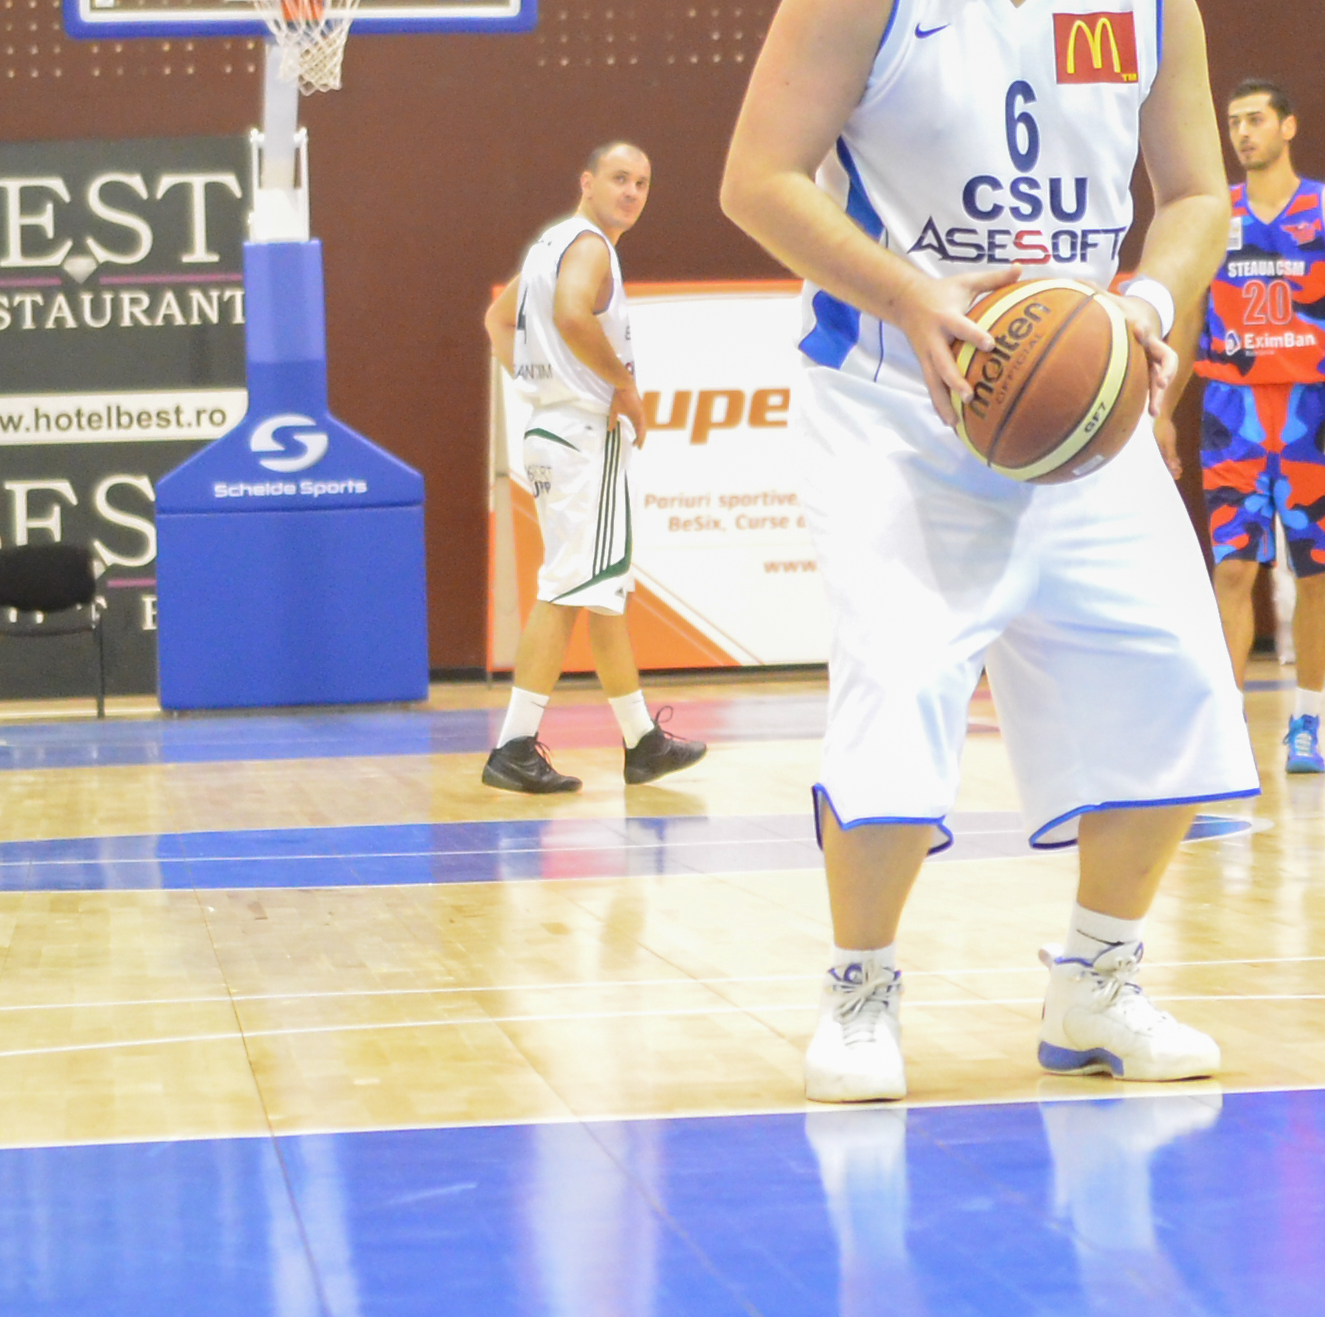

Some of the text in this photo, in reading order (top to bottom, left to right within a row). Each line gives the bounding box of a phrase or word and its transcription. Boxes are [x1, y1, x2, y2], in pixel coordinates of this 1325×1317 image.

[1003, 78, 1040, 174] 6
[961, 174, 1088, 223] CSU
[907, 214, 1129, 266] ASESOFT
[1228, 260, 1275, 278] STEAUA
[1241, 278, 1292, 326] 20
[968, 301, 1050, 420] molten
[214, 480, 368, 499] Schelde Sports
[644, 491, 712, 510] Pariuri
[734, 514, 790, 531] Curse
